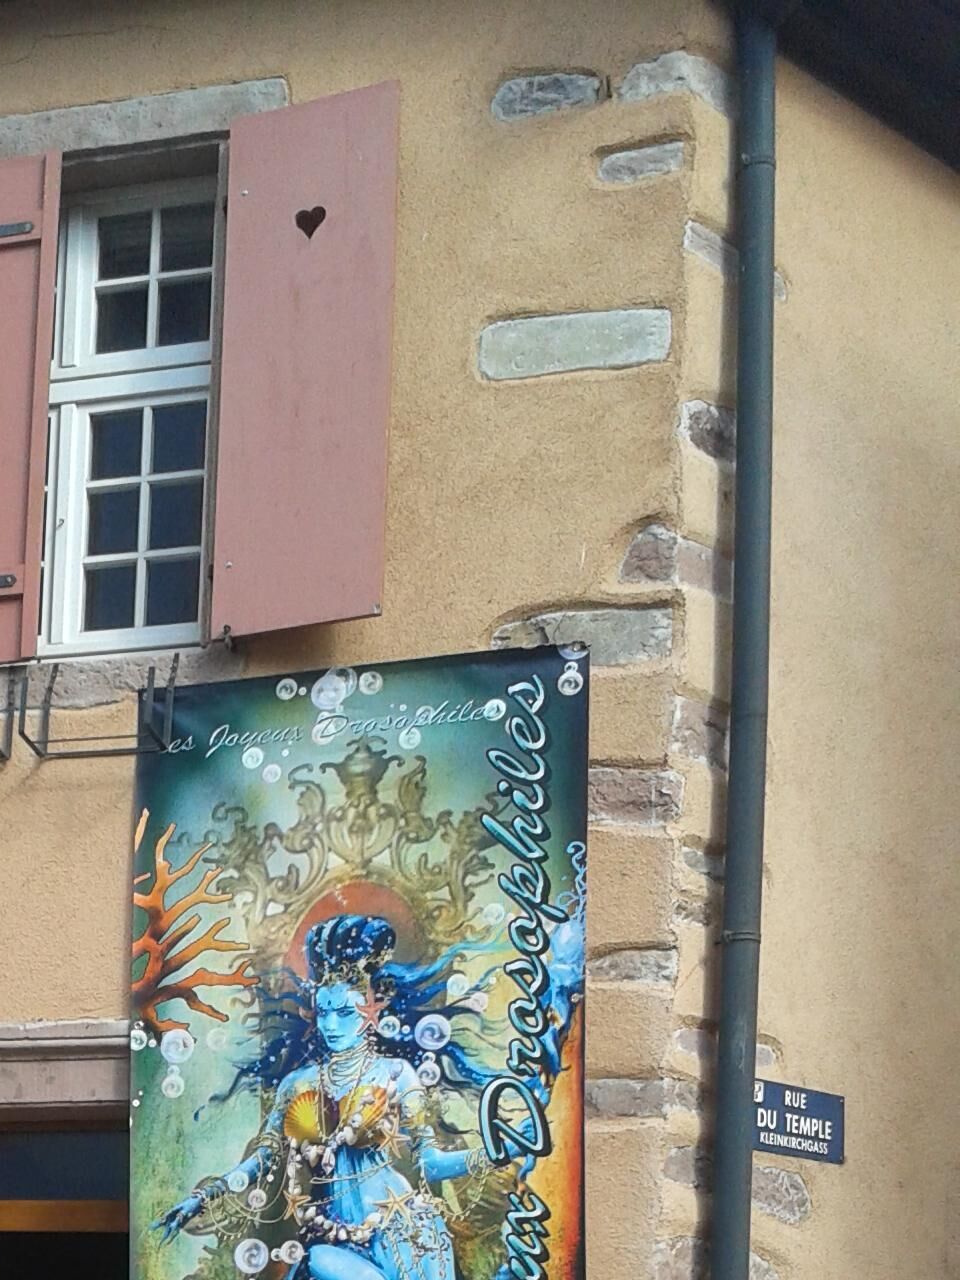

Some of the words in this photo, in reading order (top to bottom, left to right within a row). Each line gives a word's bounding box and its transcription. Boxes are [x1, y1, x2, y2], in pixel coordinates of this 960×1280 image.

[205, 724, 304, 758] Joyeux
[317, 699, 506, 739] Drosophiles
[480, 674, 568, 1163] Drosophiles
[783, 1089, 808, 1110] RUE
[756, 1107, 778, 1130] DU
[784, 1112, 834, 1140] TEMPLE
[759, 1131, 829, 1155] KLEINKIRCHGASS
